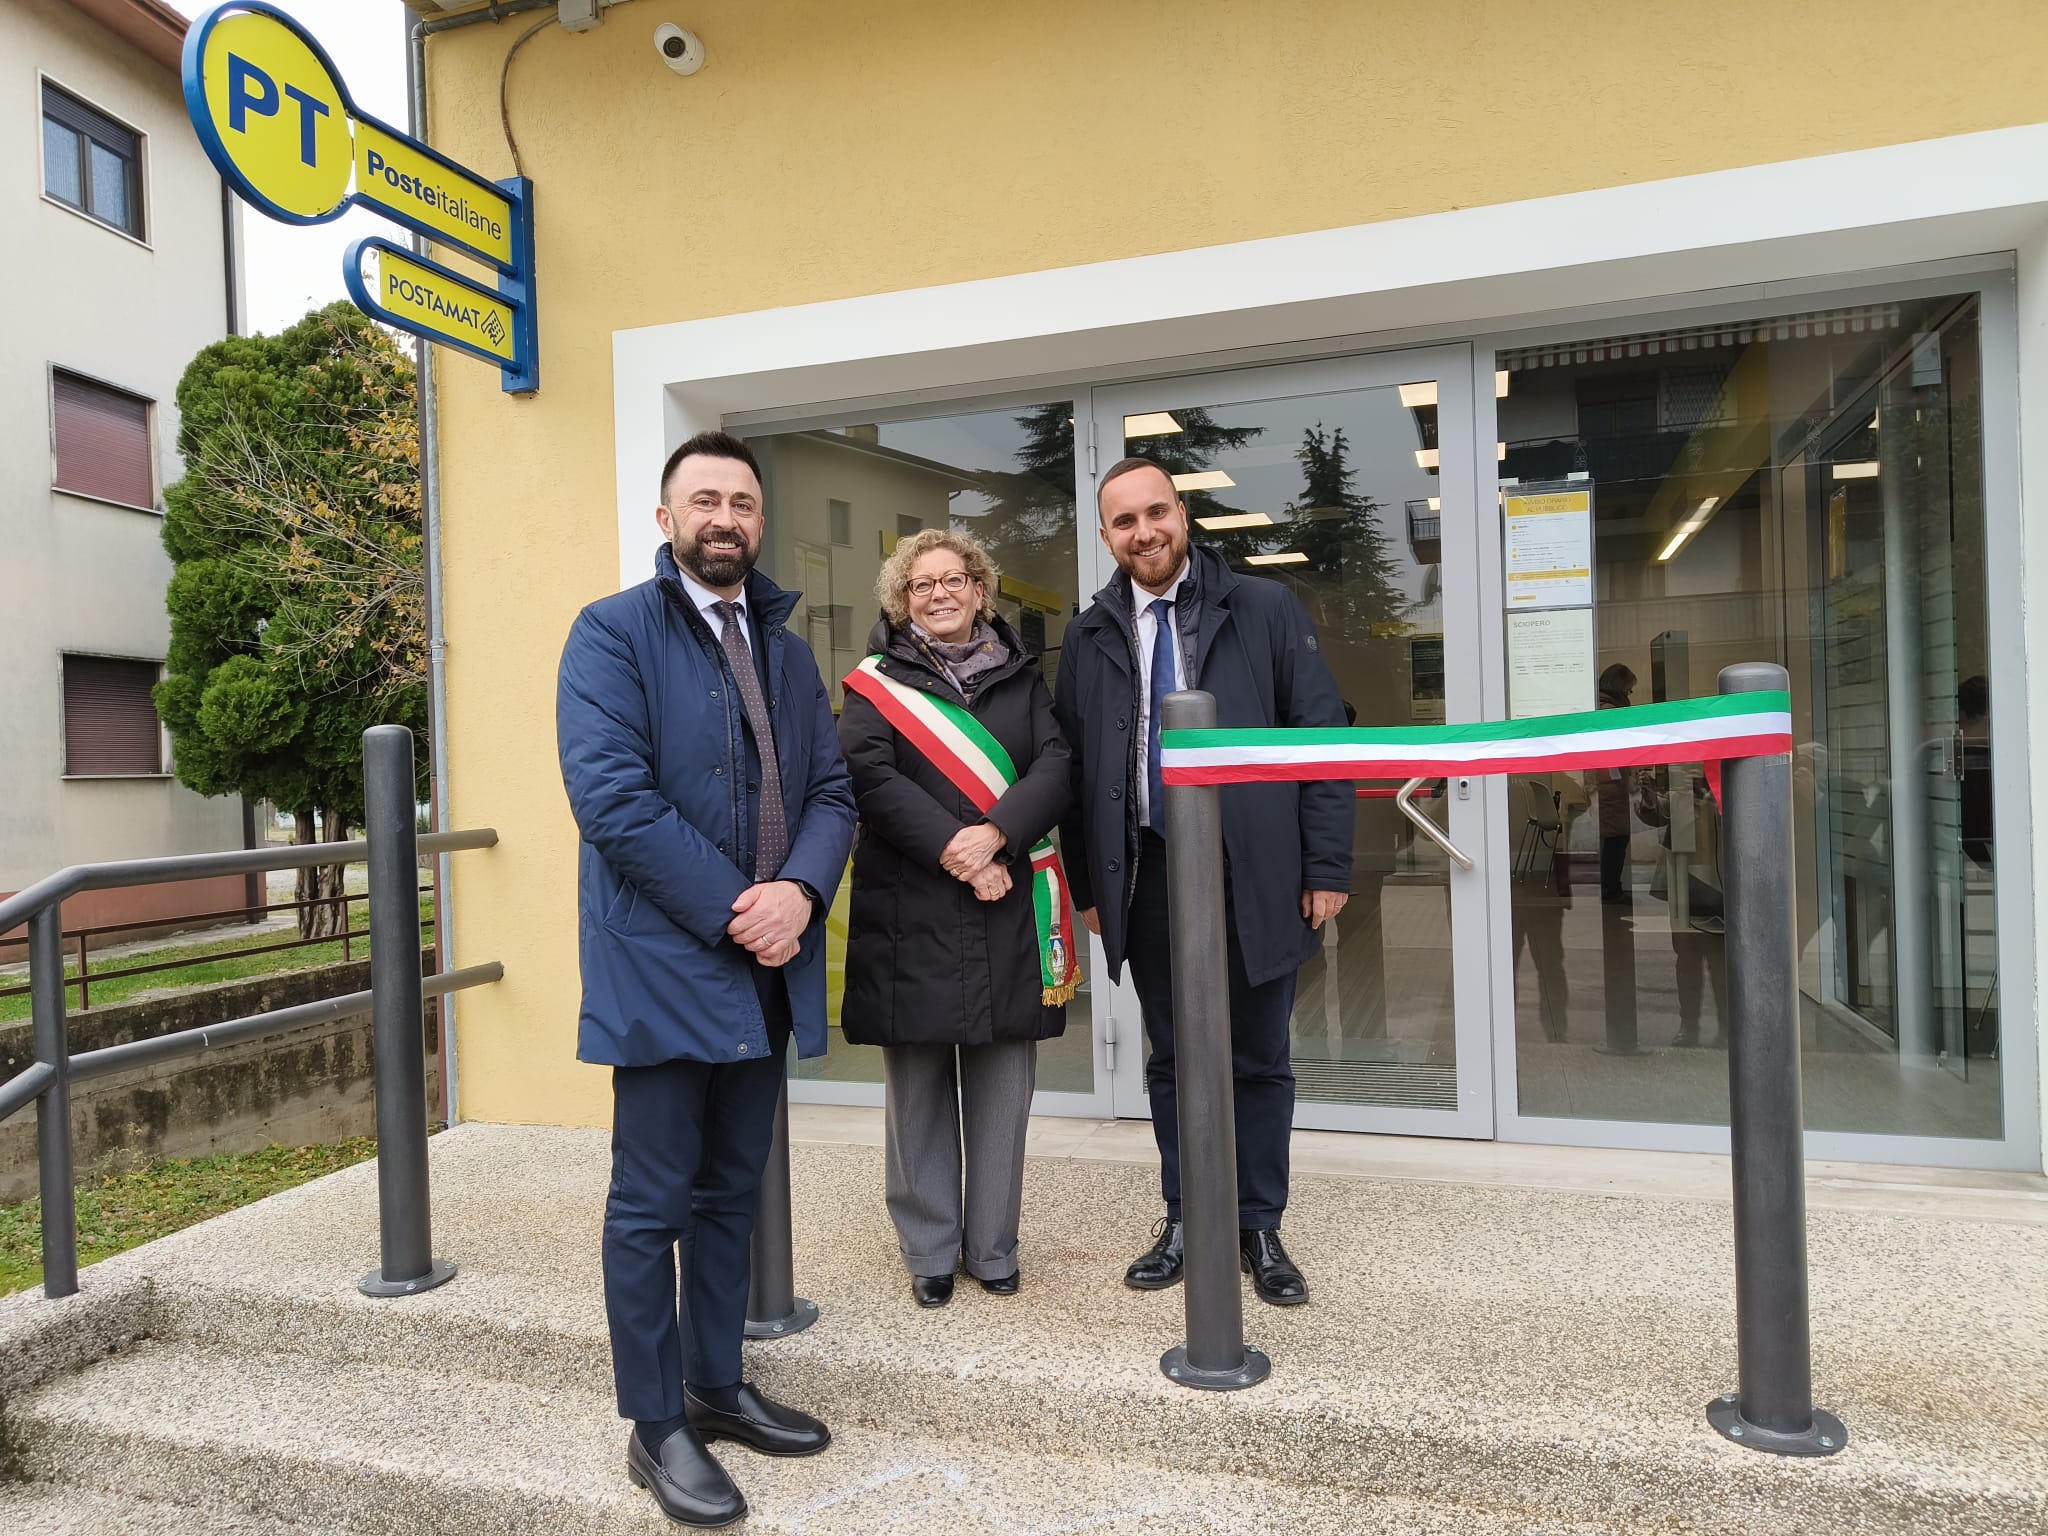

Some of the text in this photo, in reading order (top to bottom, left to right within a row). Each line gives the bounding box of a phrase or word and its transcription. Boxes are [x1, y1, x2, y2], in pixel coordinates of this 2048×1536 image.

[228, 52, 329, 168] PT
[368, 149, 501, 241] Posteitaliane
[389, 273, 480, 329] POSTAMAT
